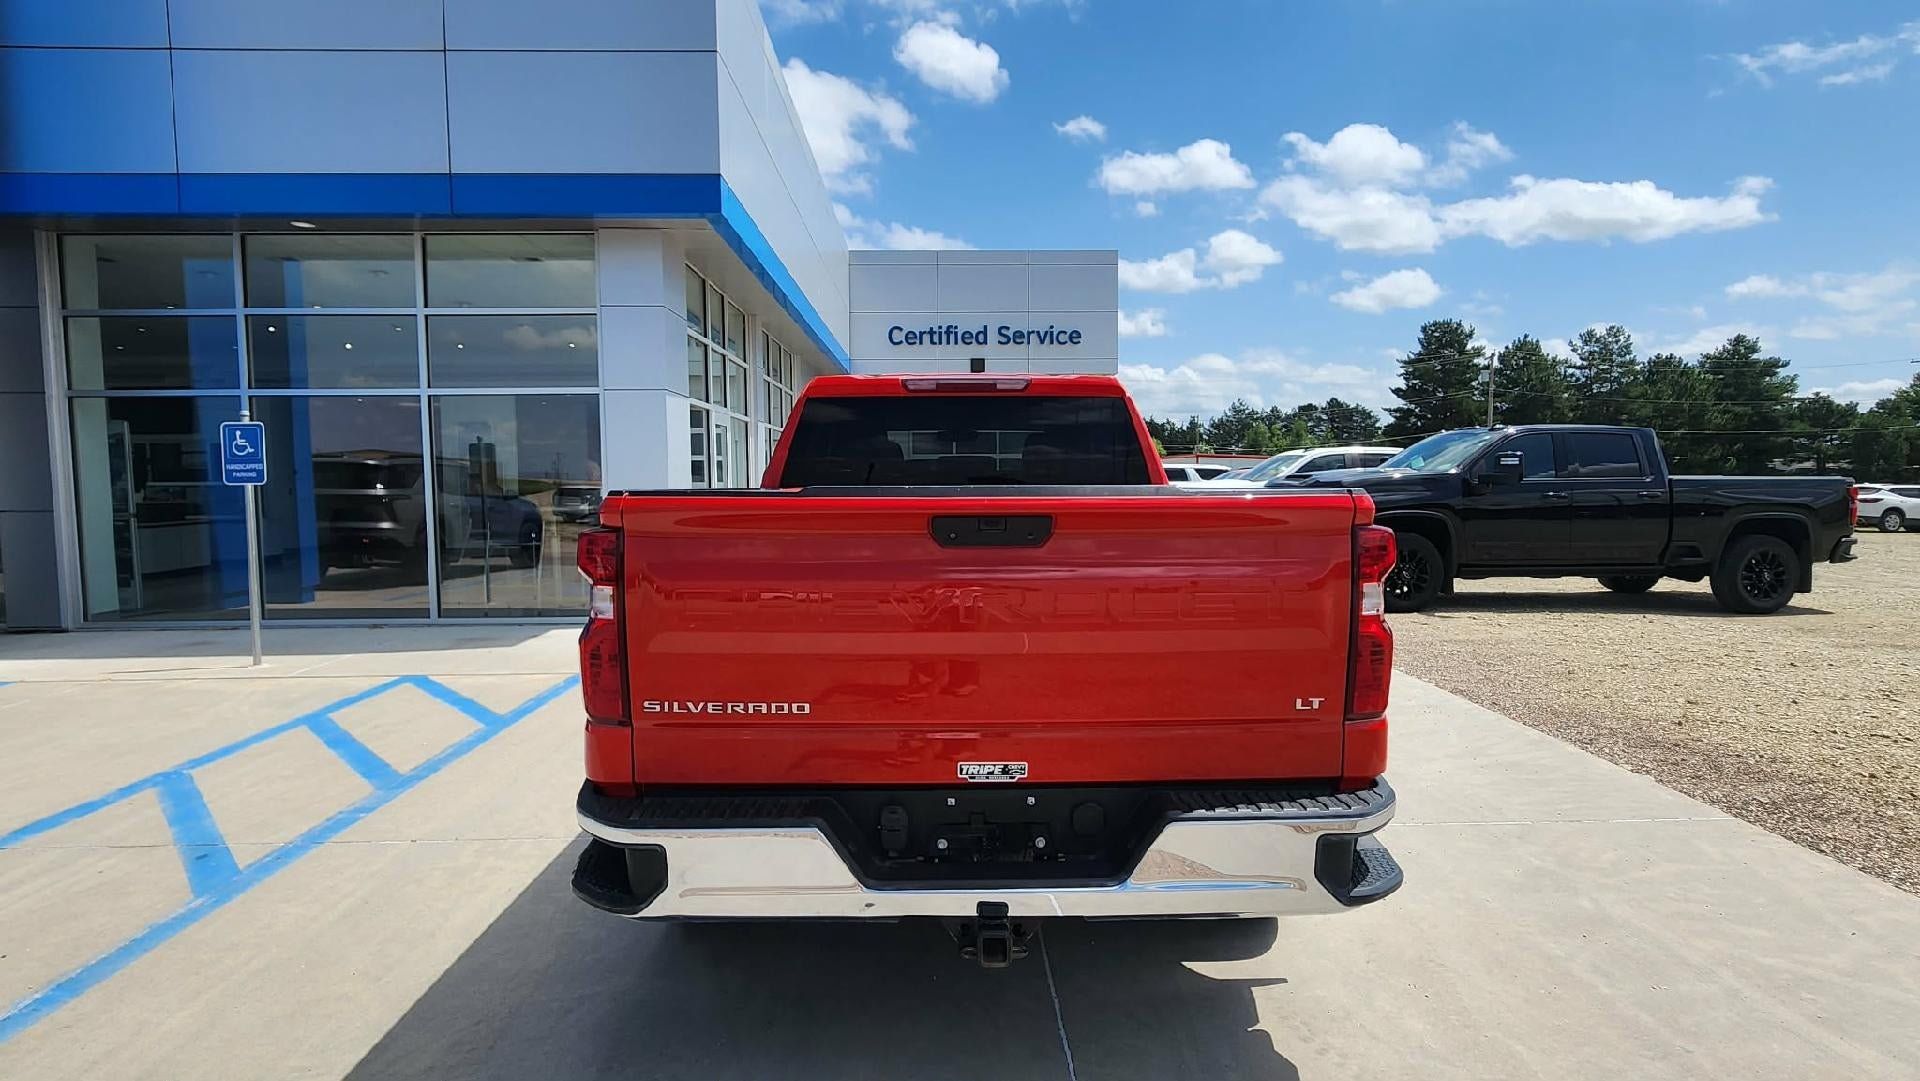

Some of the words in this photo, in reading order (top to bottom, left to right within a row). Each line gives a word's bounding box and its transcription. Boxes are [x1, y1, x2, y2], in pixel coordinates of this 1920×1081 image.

[888, 324, 988, 346] Certified
[997, 324, 1082, 346] Service
[226, 463, 263, 471] HANDICAPPED
[642, 700, 811, 715] SILVERADO
[1295, 697, 1326, 711] LT
[960, 764, 1004, 775] TRIPE
